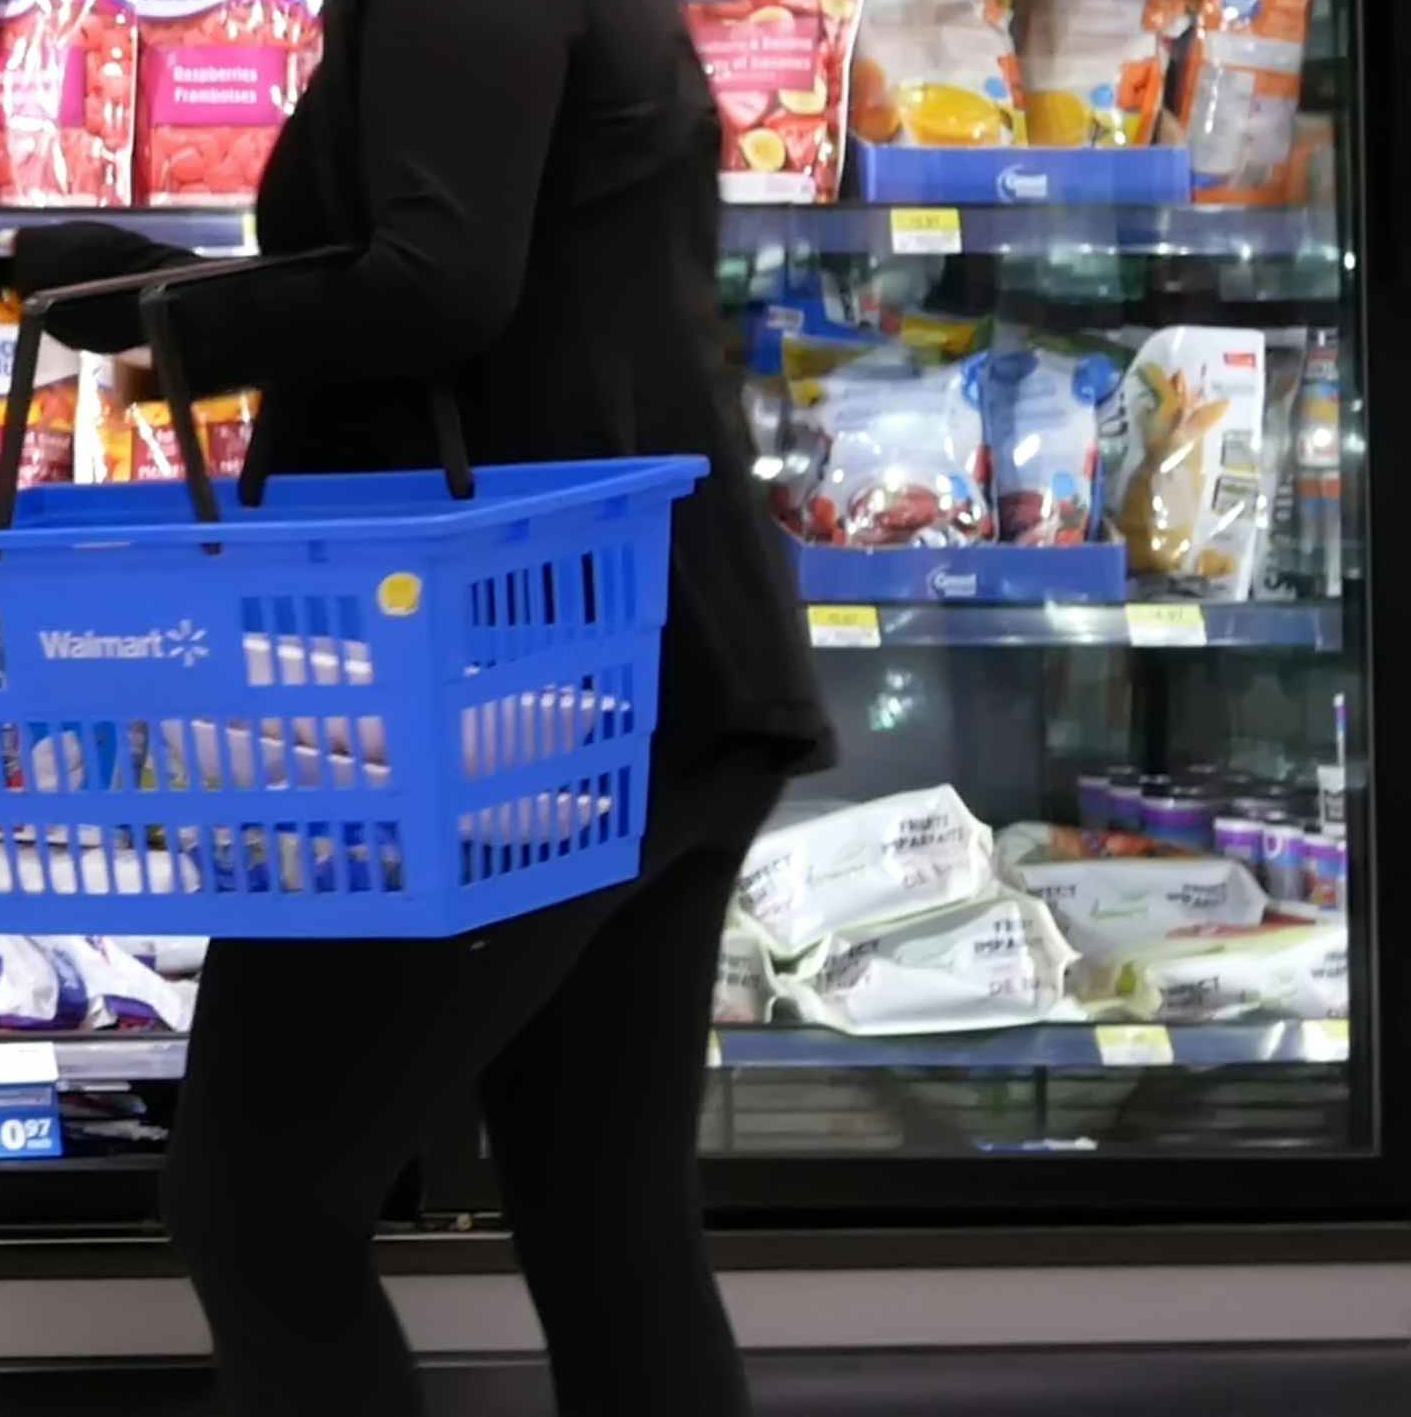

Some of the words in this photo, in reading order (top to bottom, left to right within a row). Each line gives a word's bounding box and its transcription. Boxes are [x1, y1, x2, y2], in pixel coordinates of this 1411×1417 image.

[172, 64, 258, 85] Raspberries
[173, 86, 257, 105] Framboises
[39, 629, 164, 660] Walmart
